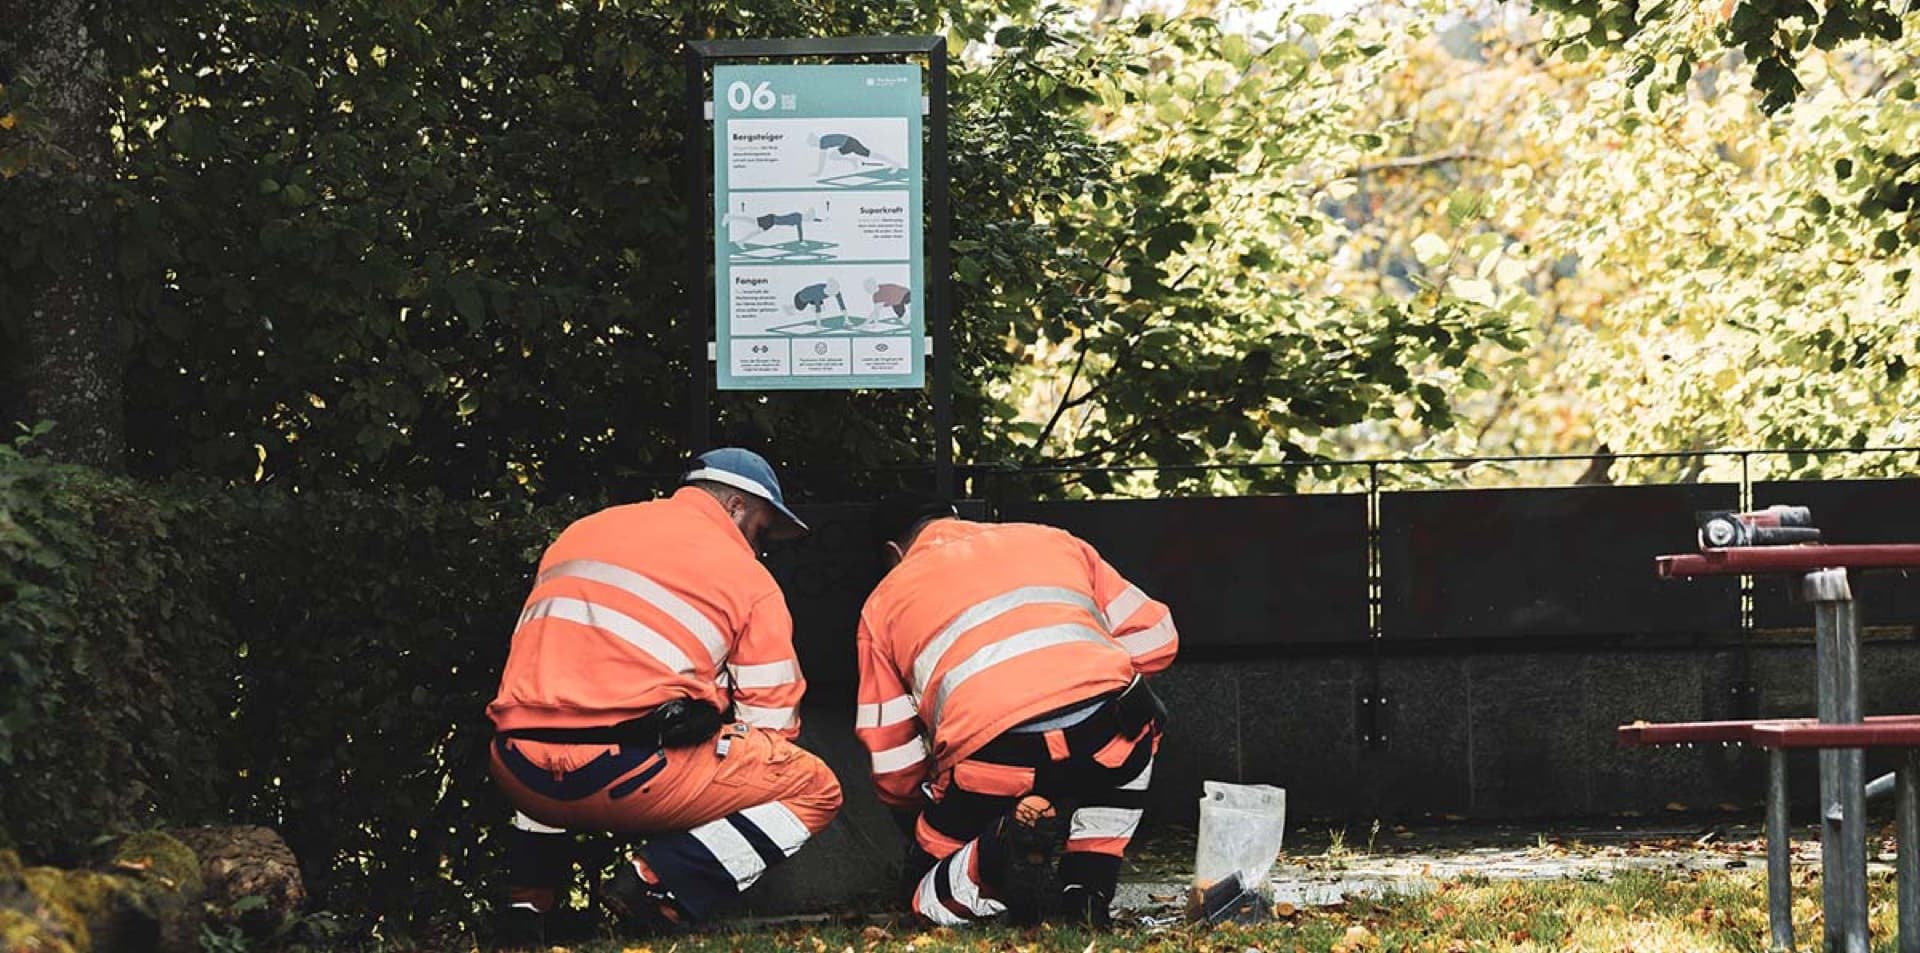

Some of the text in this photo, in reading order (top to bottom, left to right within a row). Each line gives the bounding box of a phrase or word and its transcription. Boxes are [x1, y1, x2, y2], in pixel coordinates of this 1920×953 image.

[727, 81, 776, 111] 06
[733, 133, 783, 142] Bergsteiger
[860, 206, 903, 214] Superkraft
[735, 277, 768, 286] Fangen
